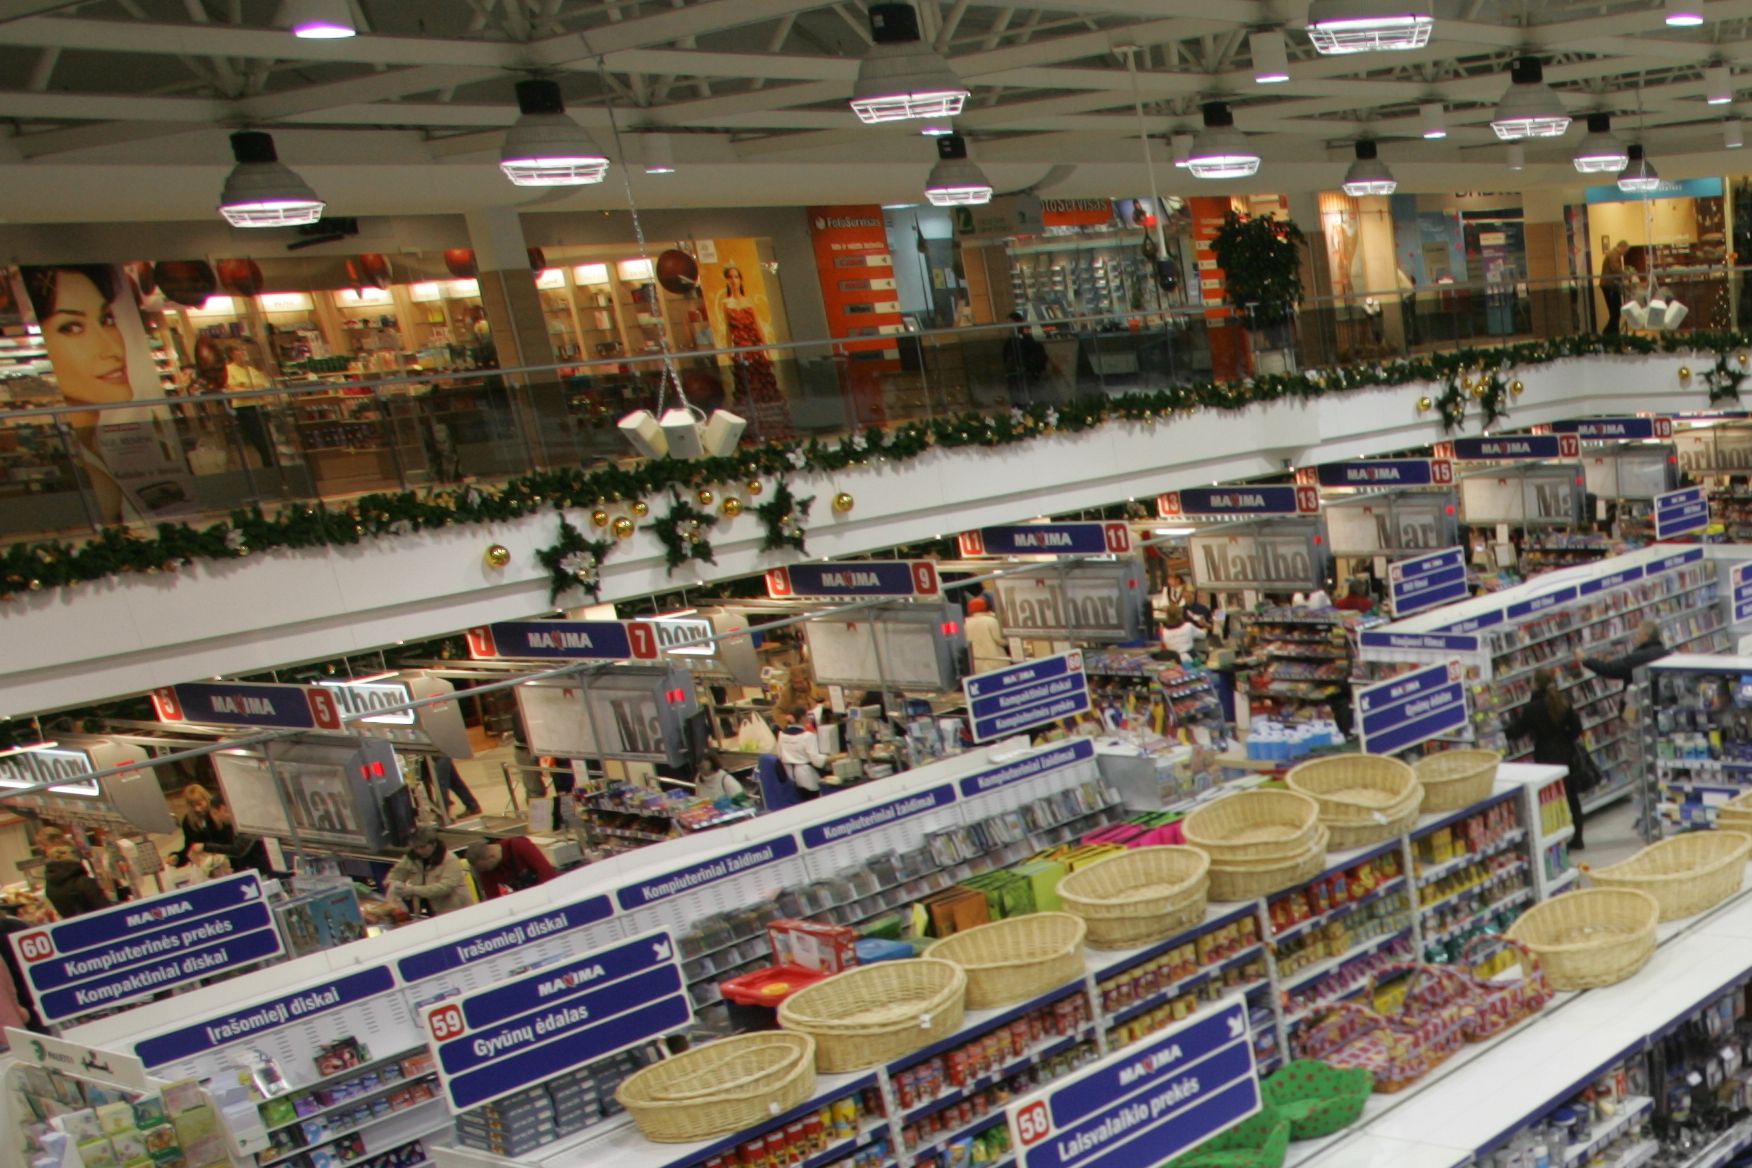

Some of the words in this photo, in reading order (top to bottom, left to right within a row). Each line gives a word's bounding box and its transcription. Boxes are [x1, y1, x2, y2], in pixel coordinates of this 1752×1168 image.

[1655, 421, 1670, 436] 19
[1481, 442, 1530, 454] MAXIMA
[1561, 438, 1576, 454] 17
[1347, 468, 1400, 480] MAXIMA
[1433, 463, 1450, 481] 15
[1210, 494, 1265, 507] MAXIMA
[1299, 491, 1317, 510] 13
[962, 533, 981, 552] 11
[1014, 531, 1072, 548] MAXIMA
[1107, 528, 1127, 549] 11
[774, 569, 785, 591] 9
[822, 571, 880, 588] MAXIMA
[920, 568, 931, 590] 9
[476, 628, 487, 651] 7
[528, 631, 593, 650] MAXIMA
[634, 629, 646, 653] 7
[156, 687, 175, 715] 5
[211, 694, 276, 717] MAXIMA
[316, 695, 331, 724] 5
[641, 866, 727, 900] Kompiuteriniai
[126, 901, 193, 928] MAXIMA
[21, 937, 51, 960] 60
[65, 935, 180, 977] Kompiuterinės
[182, 917, 233, 948] prekės
[456, 924, 525, 964] Įrašomieji
[527, 912, 568, 939] diskai
[76, 962, 181, 1006] Kompaktiniai
[183, 948, 229, 974] diskai
[538, 964, 605, 997] MAXIMA
[206, 1007, 289, 1045] Įrašomieji
[291, 986, 340, 1015] diskai
[432, 1010, 461, 1037] 59
[474, 1025, 534, 1058] Gyvūnų
[535, 1005, 589, 1034] ėdalas
[1119, 1044, 1183, 1086] MAXIMA
[1020, 1106, 1048, 1140] 58
[1057, 1104, 1149, 1162] Laisvalaikio
[1150, 1077, 1199, 1118] prekės
